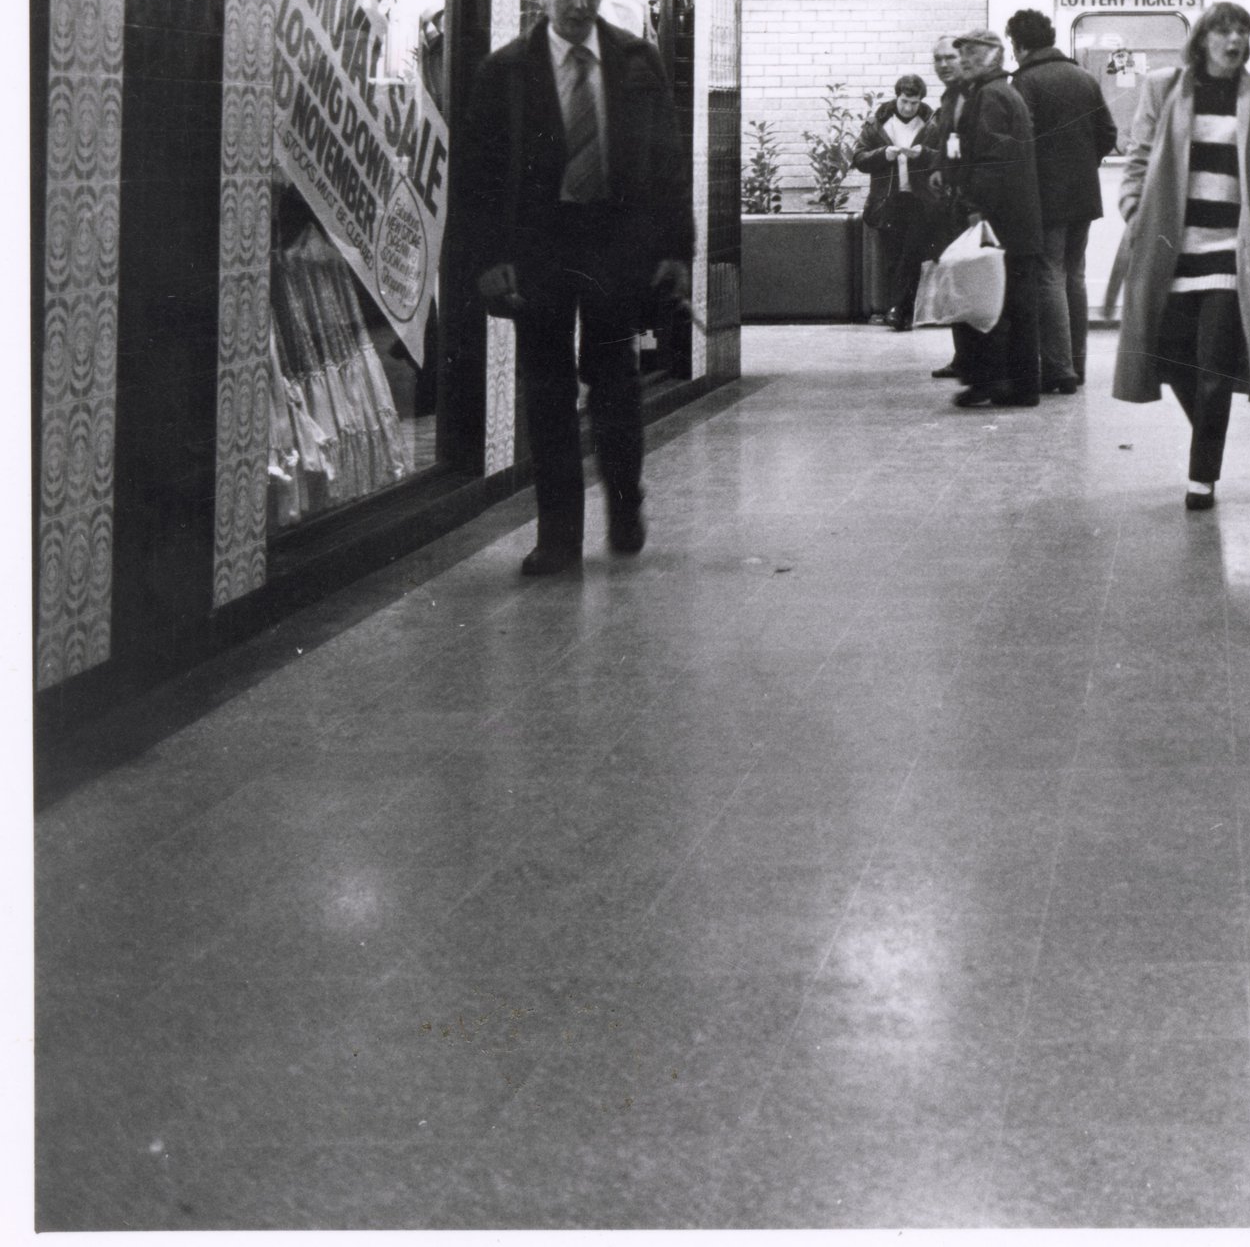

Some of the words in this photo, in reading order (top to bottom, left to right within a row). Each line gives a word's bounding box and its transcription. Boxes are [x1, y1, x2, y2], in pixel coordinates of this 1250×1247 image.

[291, 90, 377, 244] NOVEMBER
[315, 177, 338, 208] MUST
[336, 206, 348, 226] BE
[341, 95, 395, 207] DOWN
[383, 78, 447, 219] SALE
